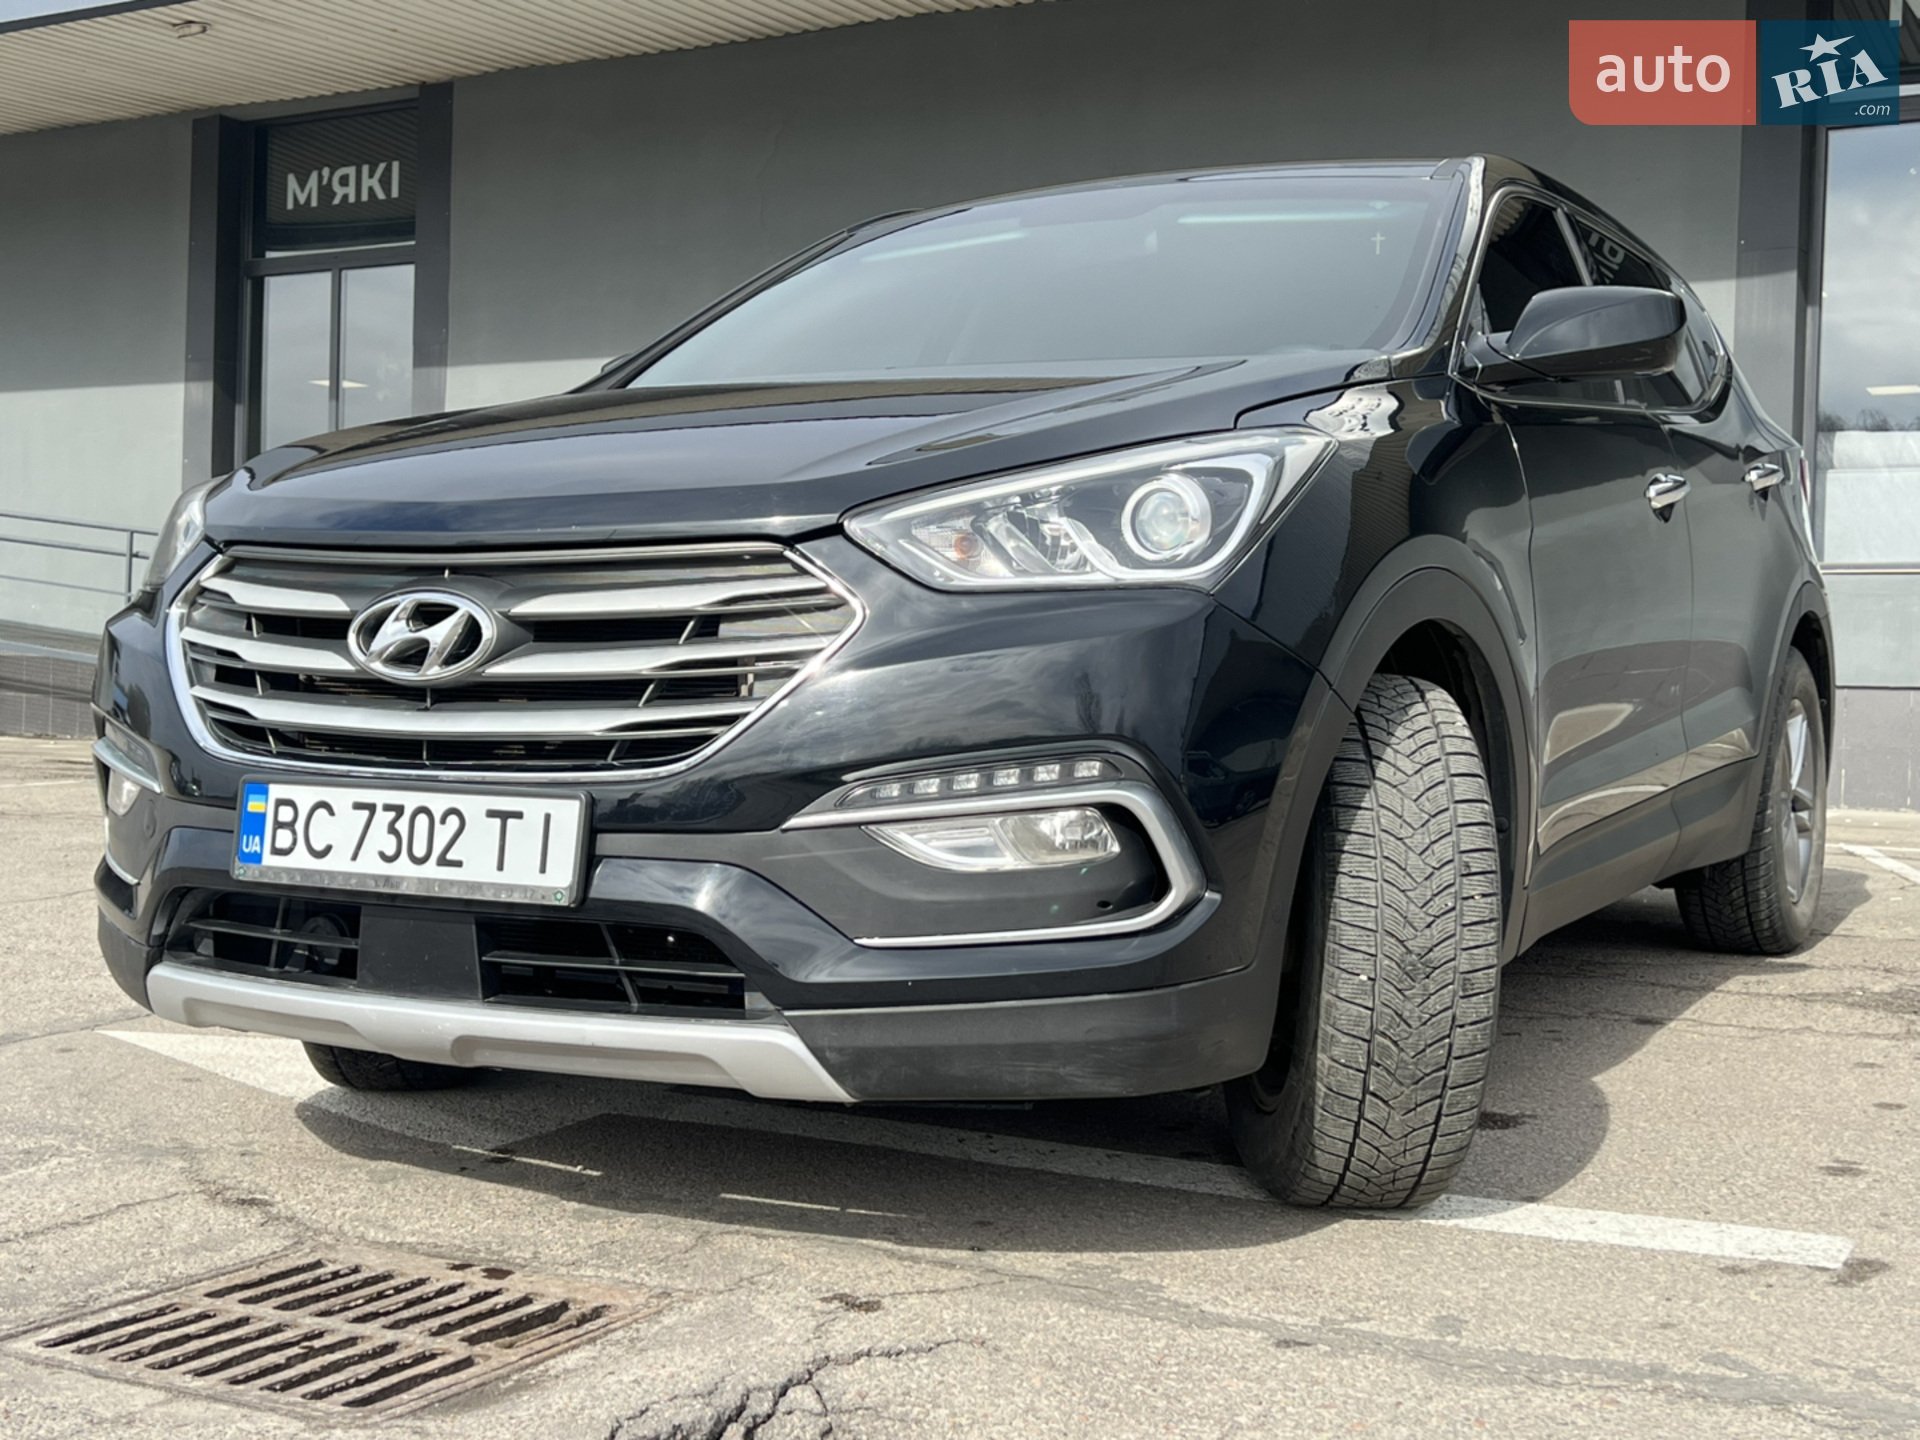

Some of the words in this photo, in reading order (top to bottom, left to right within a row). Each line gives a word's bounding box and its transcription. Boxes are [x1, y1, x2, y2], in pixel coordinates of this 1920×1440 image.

[286, 160, 399, 210] М'ЯКІ
[242, 834, 261, 854] UA
[269, 798, 336, 860] BC
[350, 801, 467, 868] 7302
